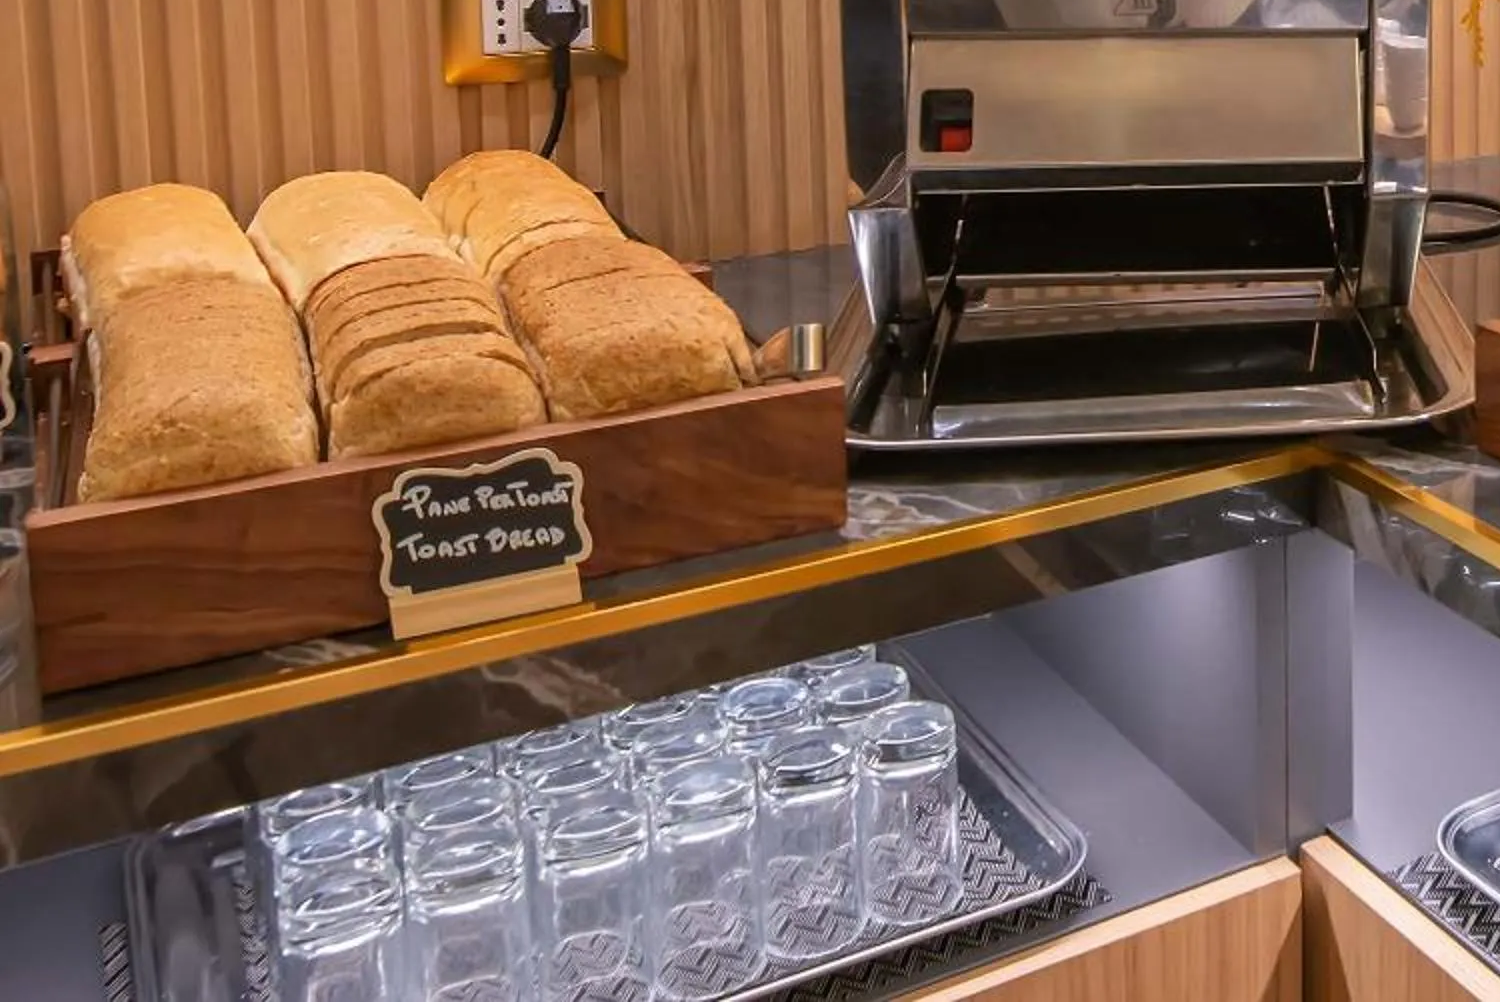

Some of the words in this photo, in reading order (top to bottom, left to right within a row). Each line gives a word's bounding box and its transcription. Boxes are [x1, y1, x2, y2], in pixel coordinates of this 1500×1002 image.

[402, 484, 471, 519] PANE
[396, 532, 479, 562] TOAST
[483, 526, 566, 553] BREAD
